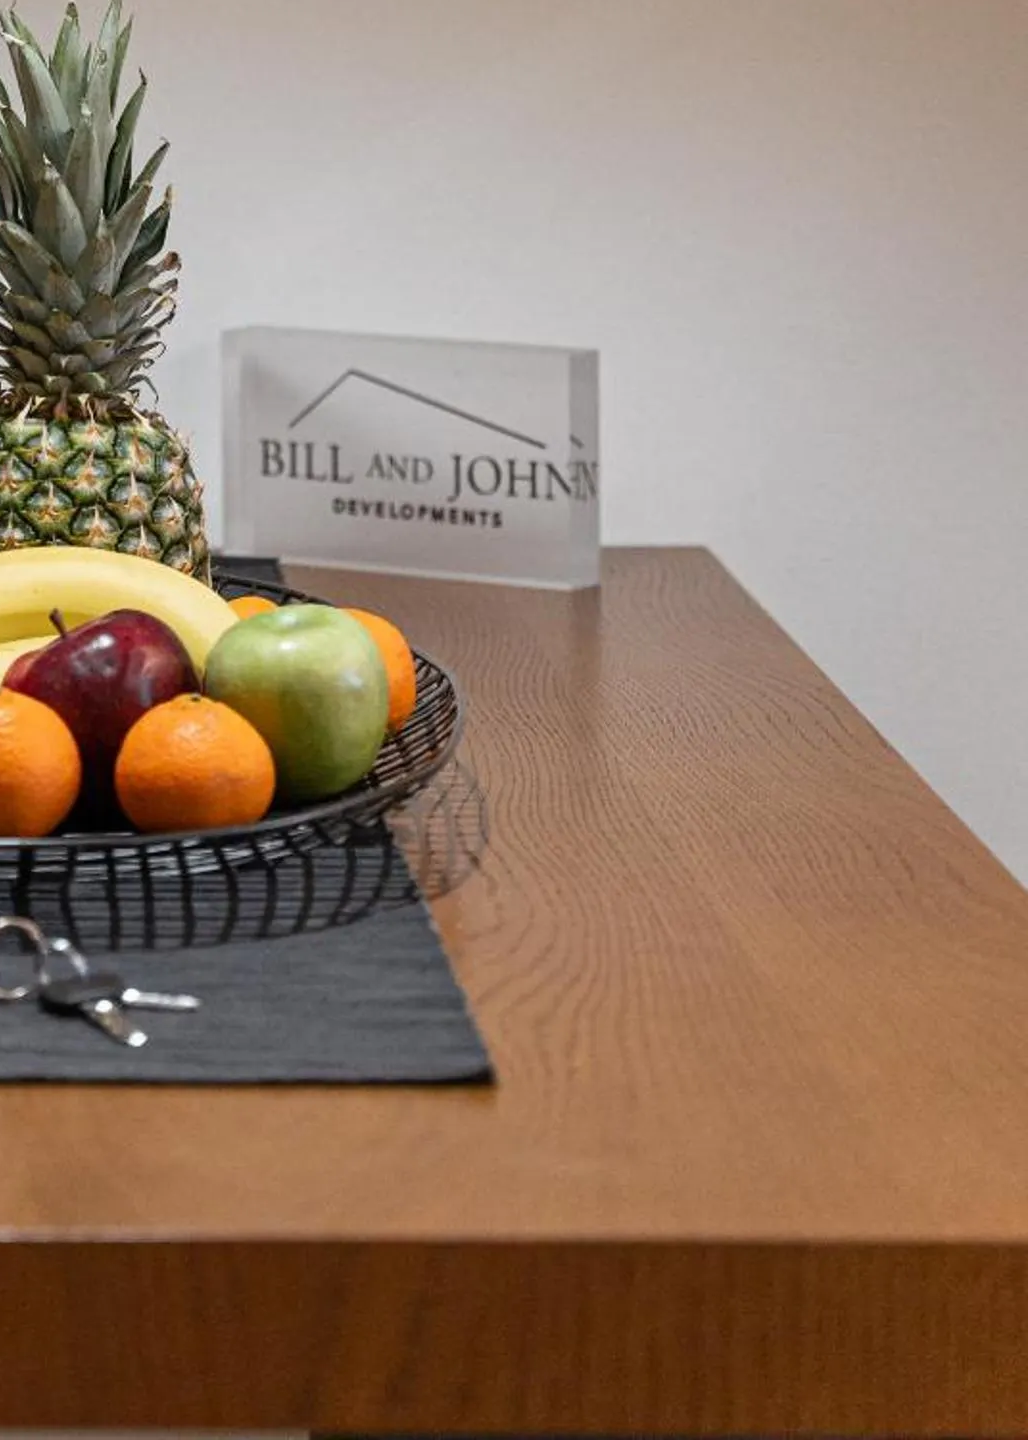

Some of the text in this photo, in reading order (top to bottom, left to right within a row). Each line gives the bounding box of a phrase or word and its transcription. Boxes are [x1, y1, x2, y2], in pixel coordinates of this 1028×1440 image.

[260, 438, 574, 501] BILL AND JOHN
[332, 496, 503, 528] DEVELOPMENTS
